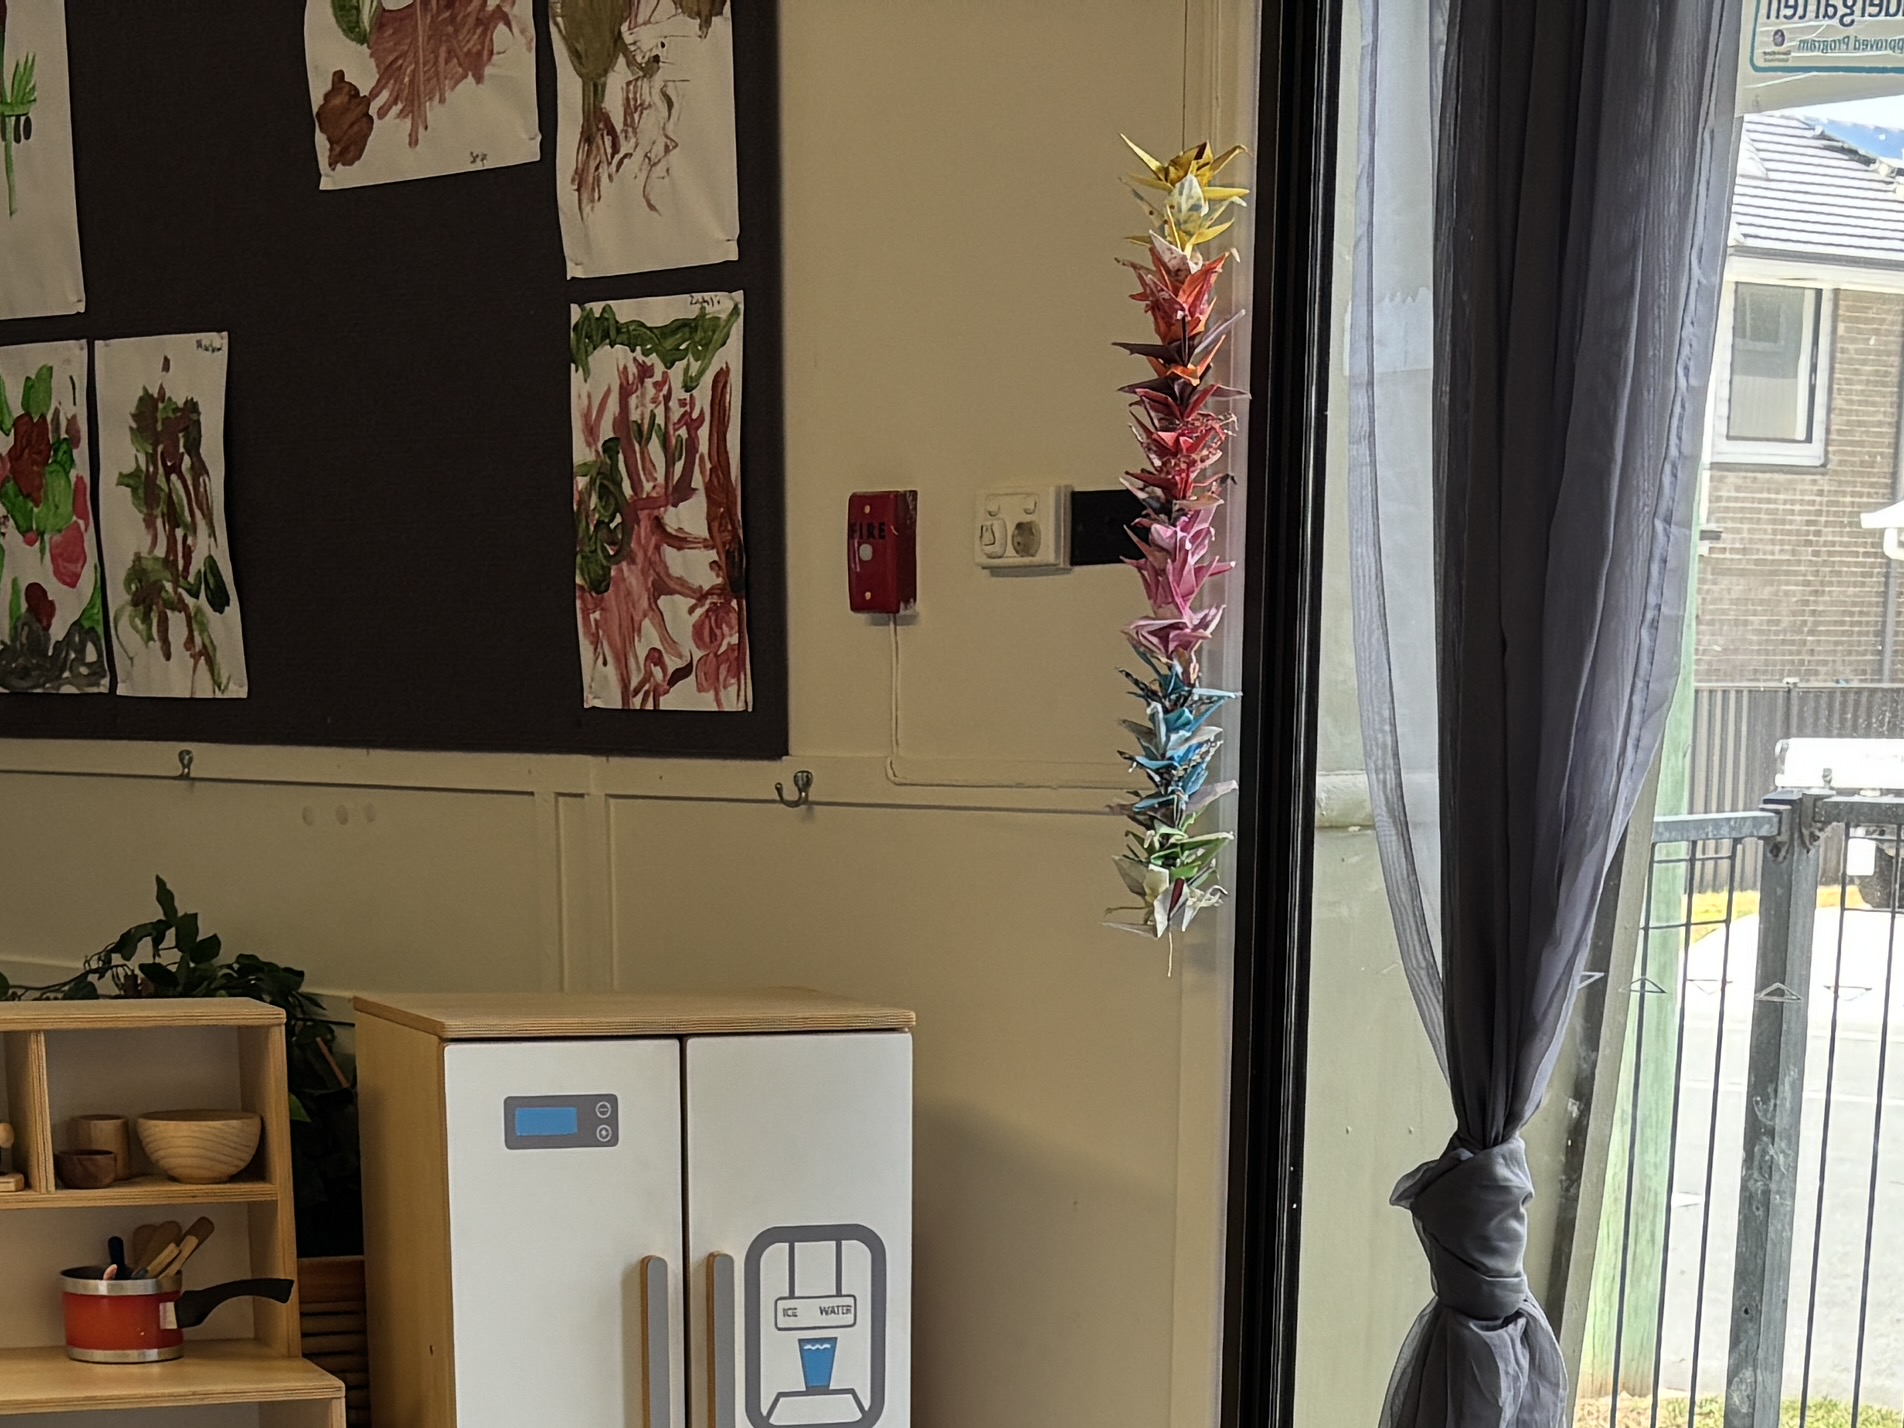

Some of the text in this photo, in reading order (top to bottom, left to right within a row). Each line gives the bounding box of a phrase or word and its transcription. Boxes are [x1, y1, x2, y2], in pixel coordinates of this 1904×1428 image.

[849, 521, 886, 540] FIRE
[782, 1304, 852, 1318] ICE WATER
